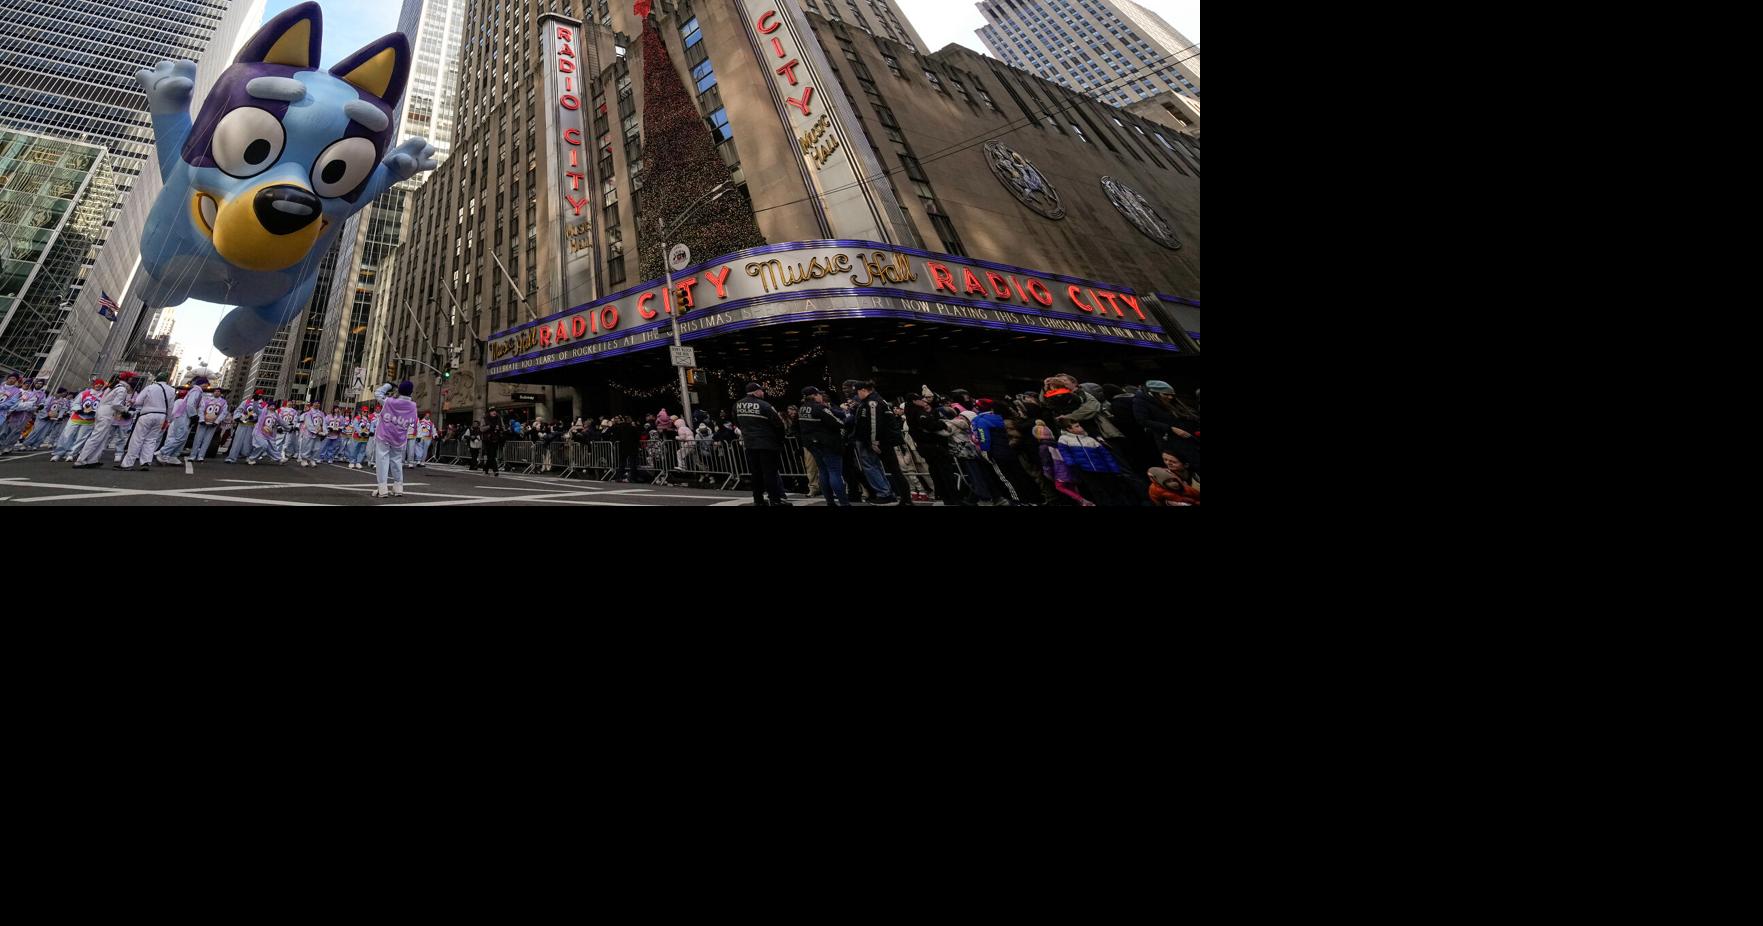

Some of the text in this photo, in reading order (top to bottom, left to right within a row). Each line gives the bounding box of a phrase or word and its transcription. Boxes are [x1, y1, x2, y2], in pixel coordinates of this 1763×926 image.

[756, 10, 815, 117] CITY
[556, 27, 588, 216] RADIO CITY
[539, 304, 619, 347] RADIO
[637, 266, 731, 319] CITY
[745, 253, 853, 294] Music
[849, 252, 919, 289] Hall
[926, 261, 1054, 307] RADIO
[1068, 284, 1147, 321] CITY
[900, 298, 930, 314] NOW
[936, 303, 988, 320] PLAYING
[993, 311, 1019, 324] THIS
[1023, 315, 1036, 326] IS
[1039, 317, 1096, 334] CHRISTMAS
[1097, 324, 1112, 336] IN
[1112, 326, 1134, 339] NEW
[1136, 330, 1164, 344] YORK
[490, 363, 519, 375] CELEBRATE
[521, 360, 534, 370] 100
[535, 355, 556, 366] YEARS
[558, 351, 569, 361] OF
[572, 340, 618, 357] ROCKETTES
[623, 335, 635, 347] AT
[736, 402, 760, 410] NYPD
